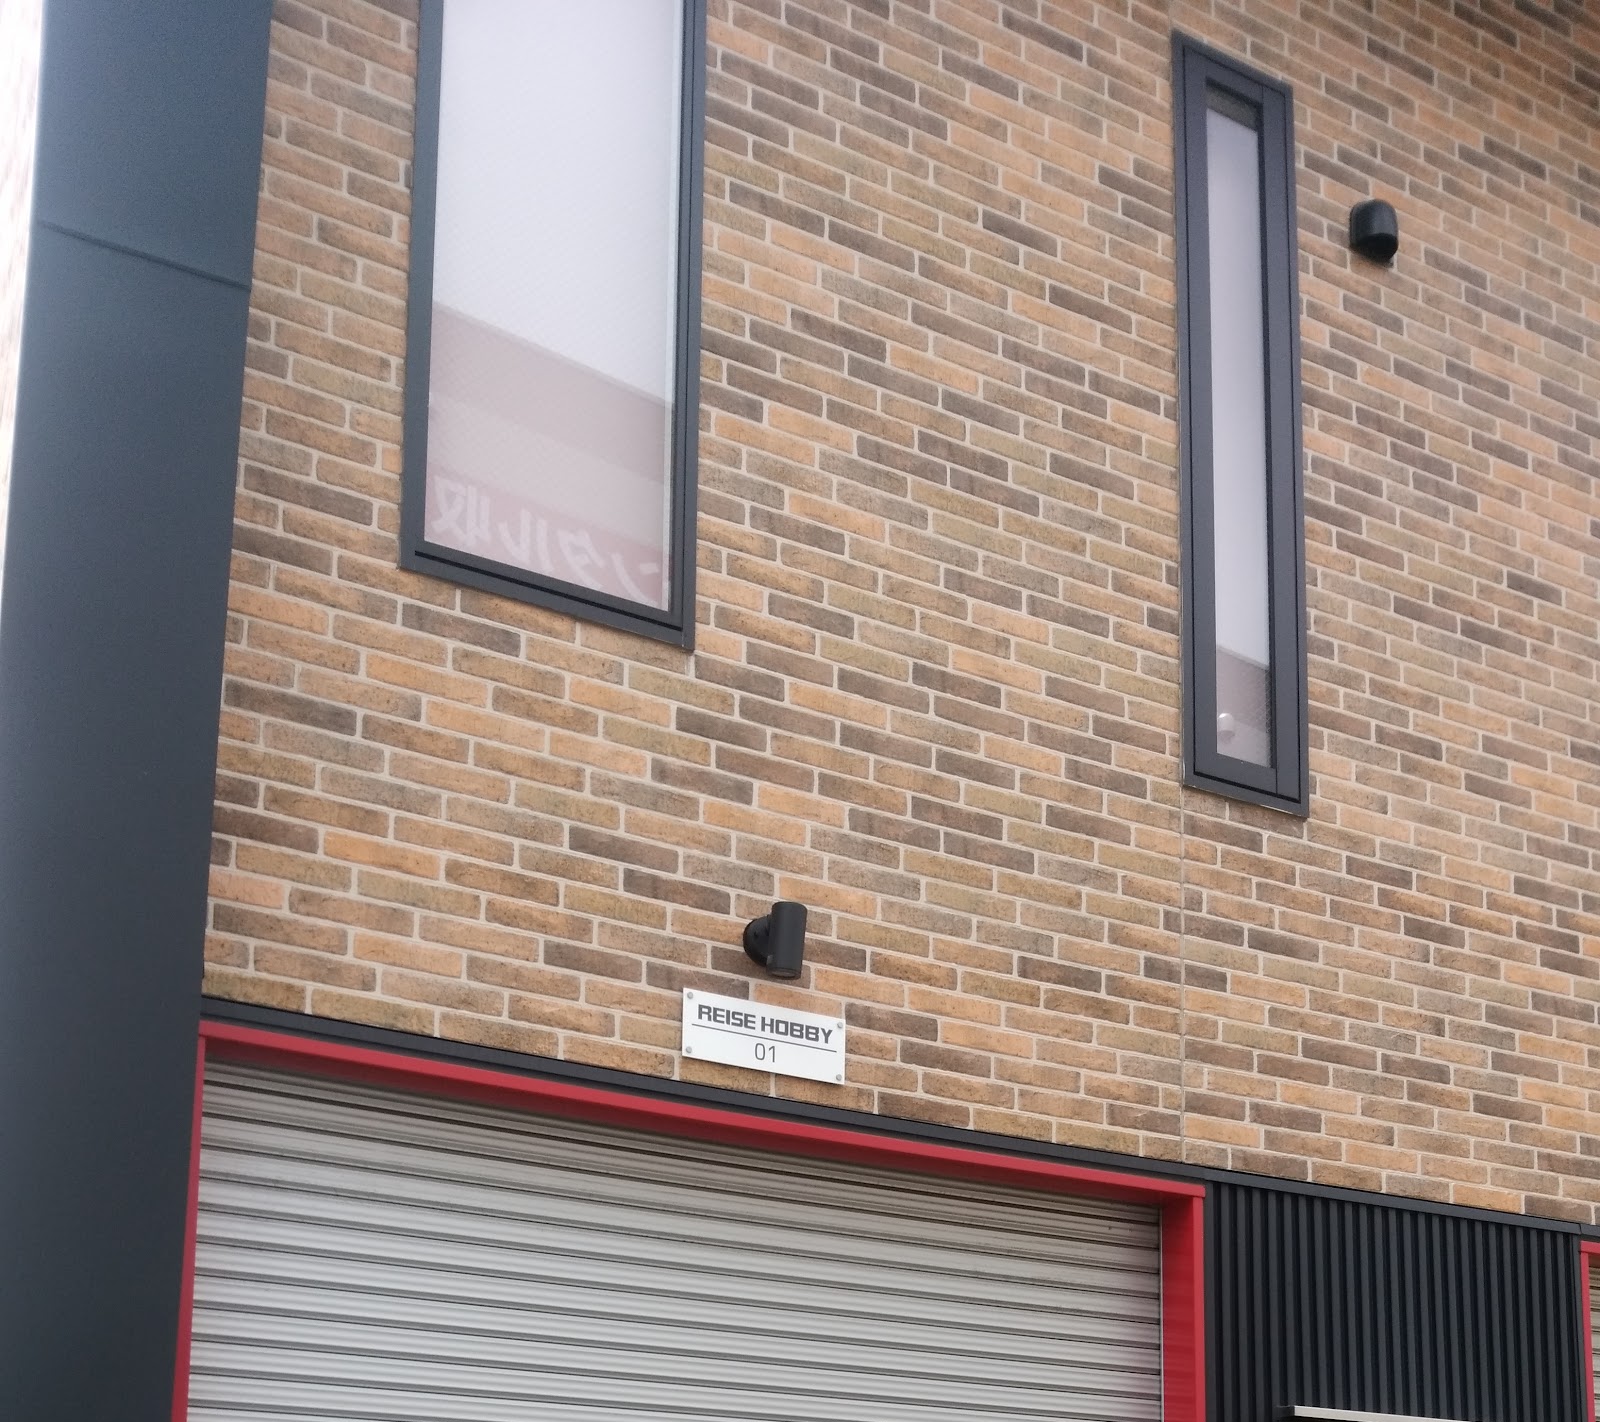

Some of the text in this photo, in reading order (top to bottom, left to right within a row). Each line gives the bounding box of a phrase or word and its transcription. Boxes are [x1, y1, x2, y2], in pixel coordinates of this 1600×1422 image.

[698, 1004, 834, 1044] REISE HOBBY
[754, 1042, 776, 1063] 01
